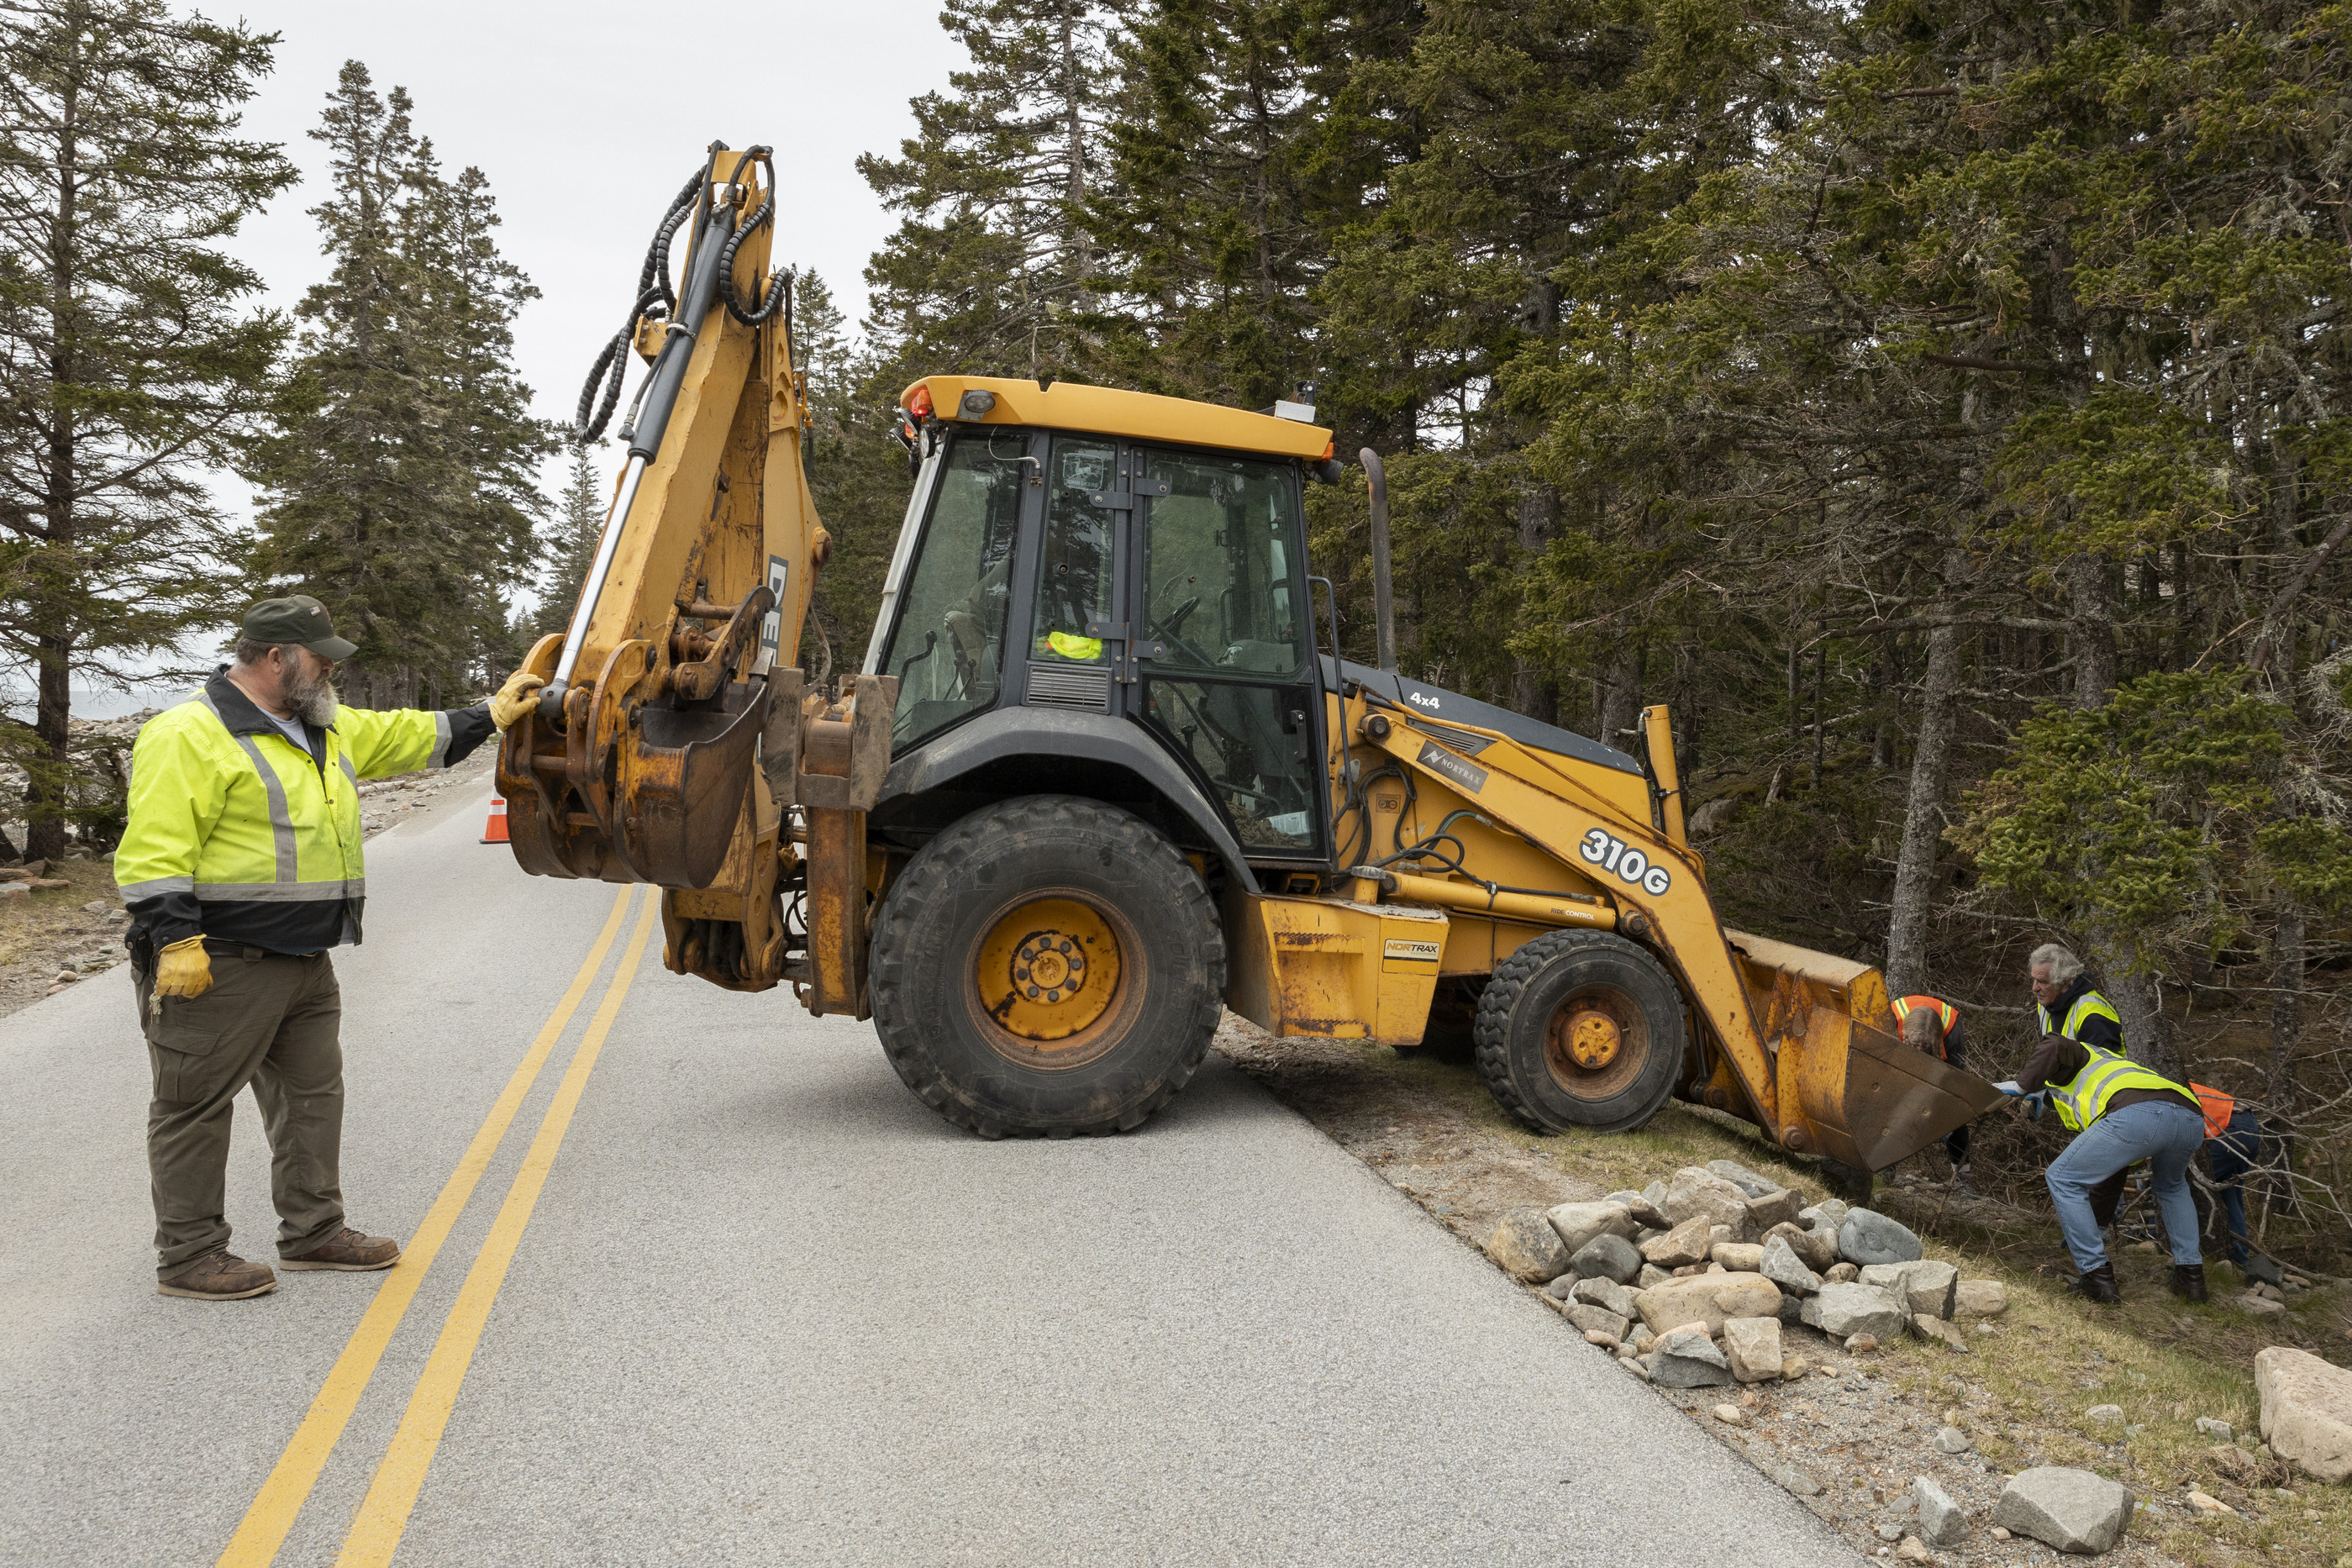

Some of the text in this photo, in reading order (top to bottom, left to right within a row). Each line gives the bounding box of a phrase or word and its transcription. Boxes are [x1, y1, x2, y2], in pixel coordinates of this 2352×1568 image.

[1410, 692, 1440, 709] 4x4
[1441, 758, 1481, 784] NORTRAX
[1581, 829, 1670, 895] 310G
[1565, 909, 1595, 921] CONTROL
[1386, 942, 1438, 953] NORTRAX
